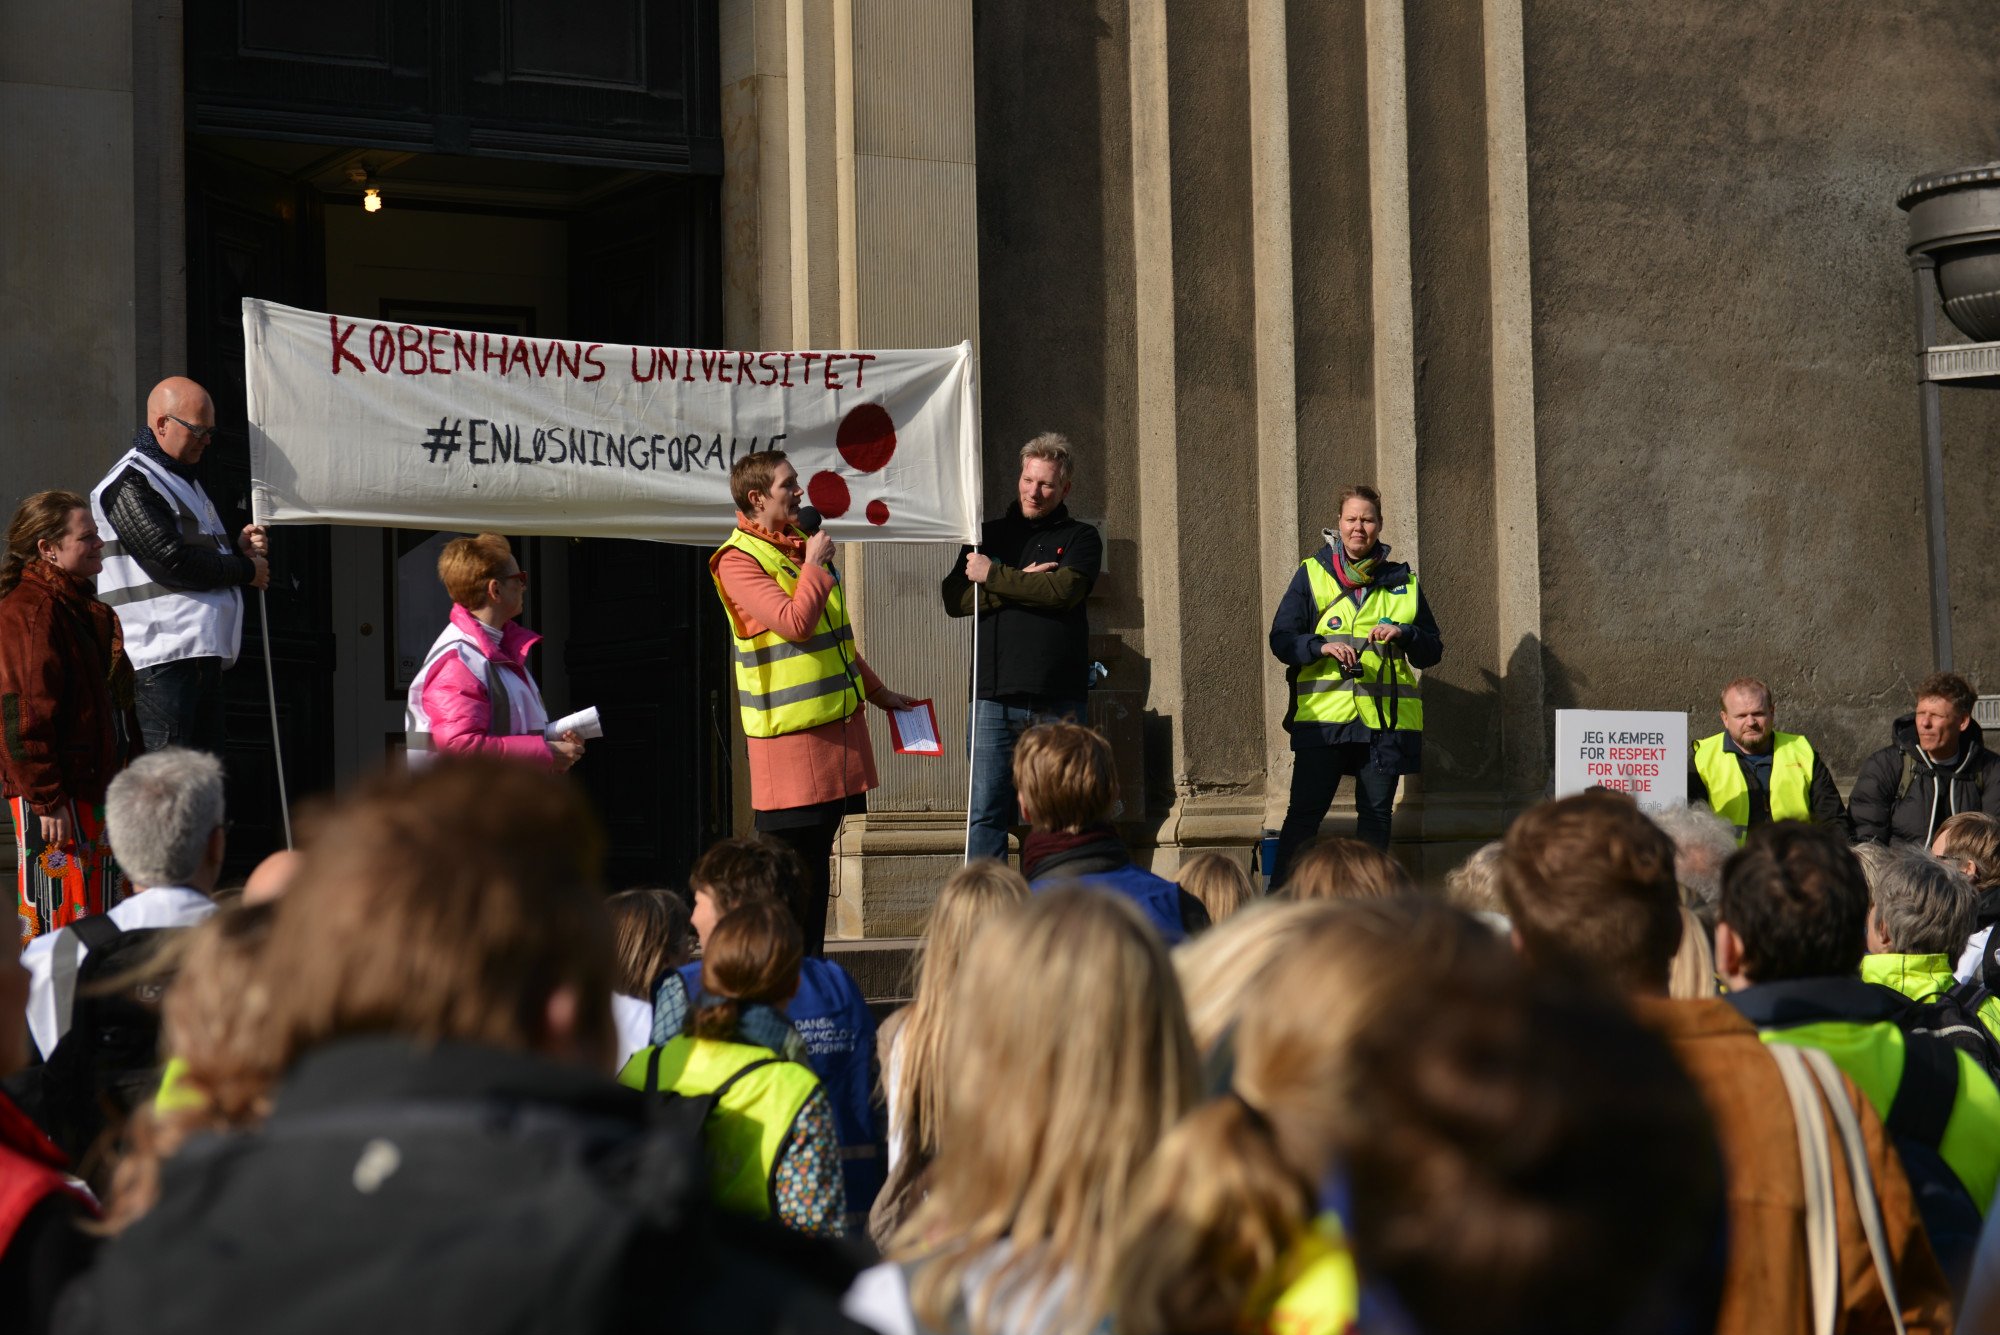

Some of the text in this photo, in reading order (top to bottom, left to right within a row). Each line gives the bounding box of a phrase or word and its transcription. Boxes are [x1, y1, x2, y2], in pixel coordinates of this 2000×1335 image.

[329, 314, 876, 390] KØBENHAVNS UNIVERSITET
[1582, 731, 1664, 745] JEG KÆMPER
[1580, 747, 1667, 761] FOR RESPEKT
[1588, 763, 1659, 776] FOR VORES
[794, 1017, 836, 1032] DANSK
